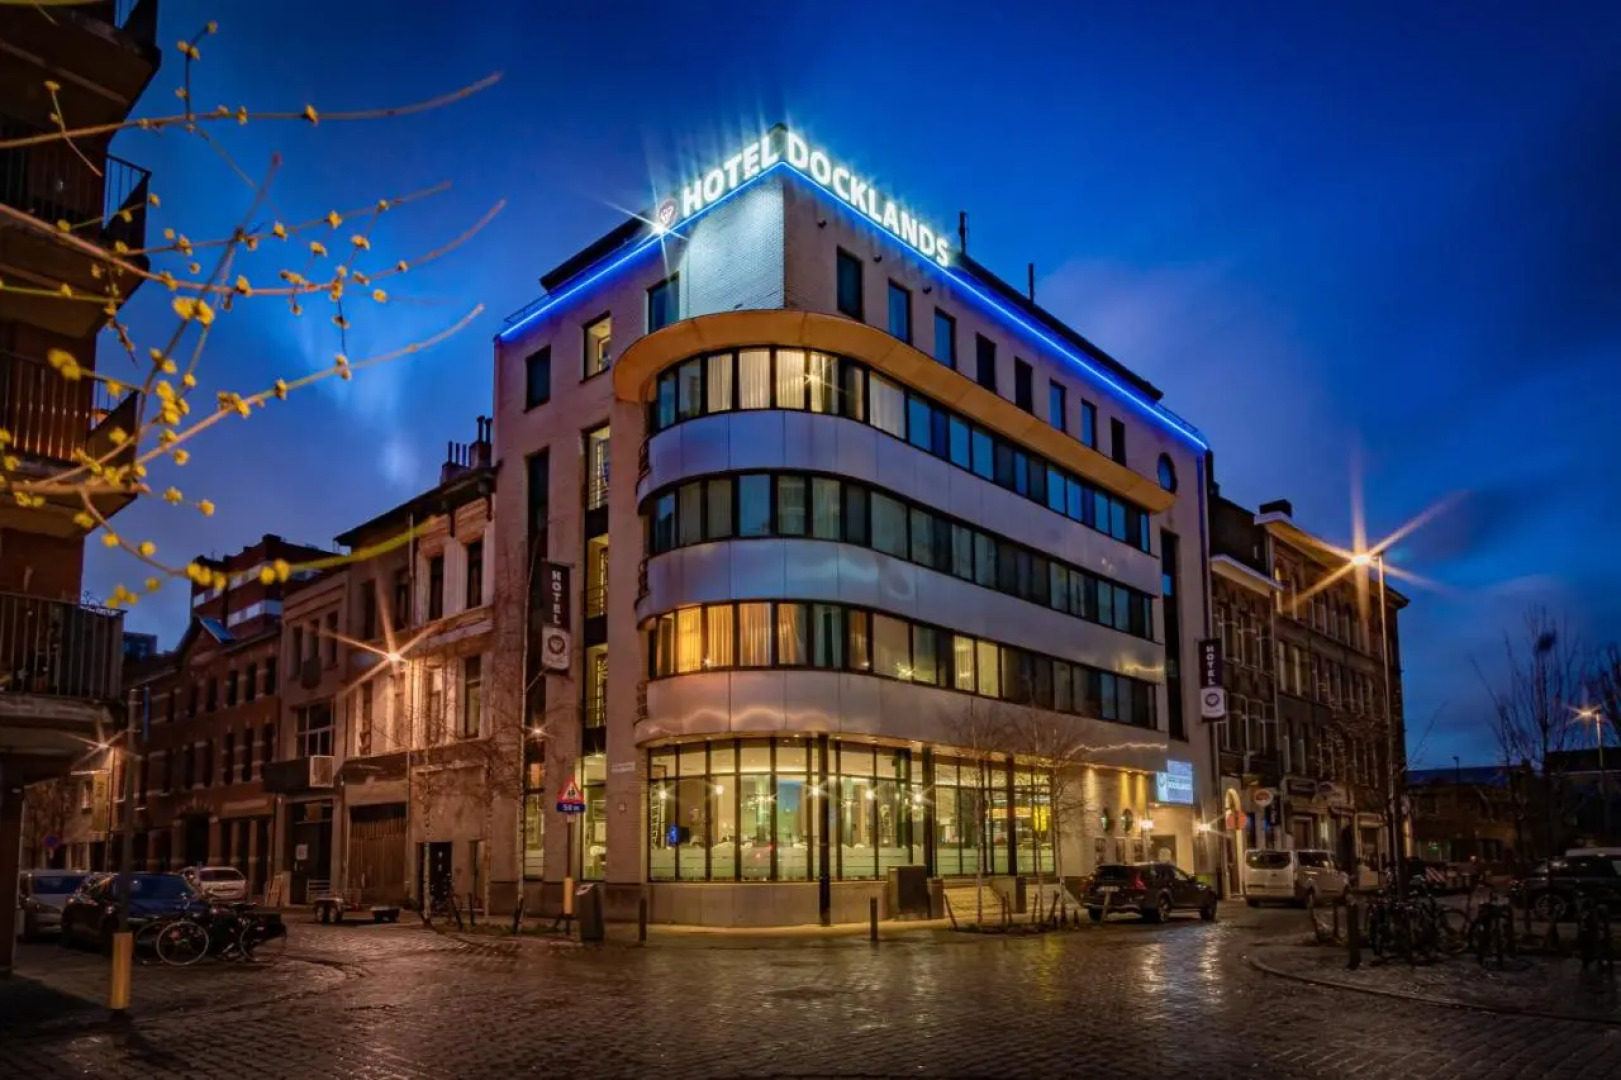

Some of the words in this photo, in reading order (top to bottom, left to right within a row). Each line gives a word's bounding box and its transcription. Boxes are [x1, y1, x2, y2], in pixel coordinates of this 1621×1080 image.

[683, 134, 777, 217] HOTEL
[787, 131, 949, 267] DOCKLANDS
[552, 570, 561, 624] HOTEL
[1206, 645, 1216, 685] HOTEL
